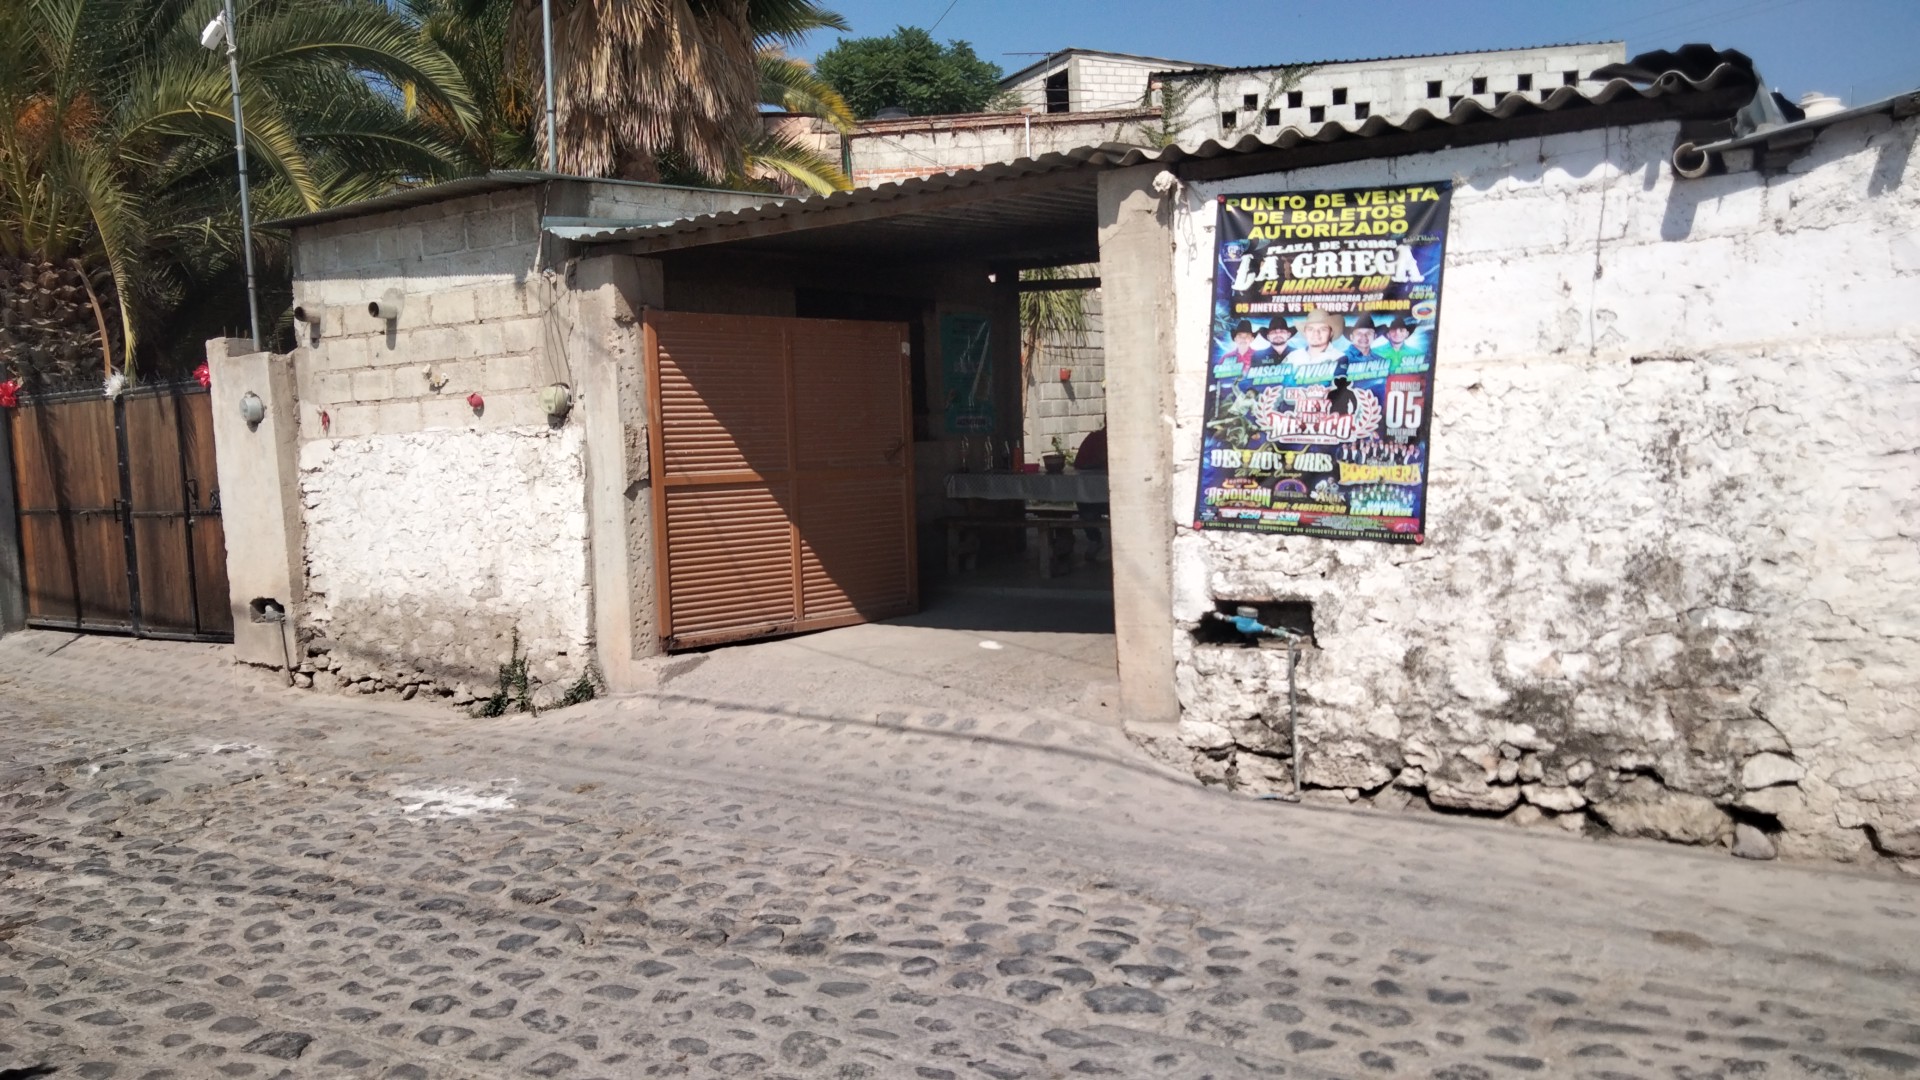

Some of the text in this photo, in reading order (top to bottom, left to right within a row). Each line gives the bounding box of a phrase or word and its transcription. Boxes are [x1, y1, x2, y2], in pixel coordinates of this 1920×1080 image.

[1226, 187, 1440, 211] PUNTO DE VENTA
[1253, 204, 1406, 225] DE BOLETOS
[1248, 220, 1408, 240] AUTORIZADO
[1267, 238, 1397, 255] PLAZA DE TOROS
[1231, 244, 1425, 291] LA GRIEGA
[1261, 280, 1278, 295] EL
[1235, 302, 1249, 313] 05
[1250, 302, 1285, 313] JINETES
[1287, 302, 1302, 312] VS
[1303, 302, 1314, 312] 15
[1315, 301, 1349, 312] TOROS
[1363, 299, 1411, 312] GANADOR
[1272, 293, 1384, 303] TERCER ELIMINATORIA 2023
[1247, 363, 1293, 379] MASCOTA
[1390, 381, 1421, 391] DOMINGO
[1297, 398, 1331, 413] REY
[1386, 390, 1423, 429] 05
[1386, 427, 1417, 437] NOVIEMBRE
